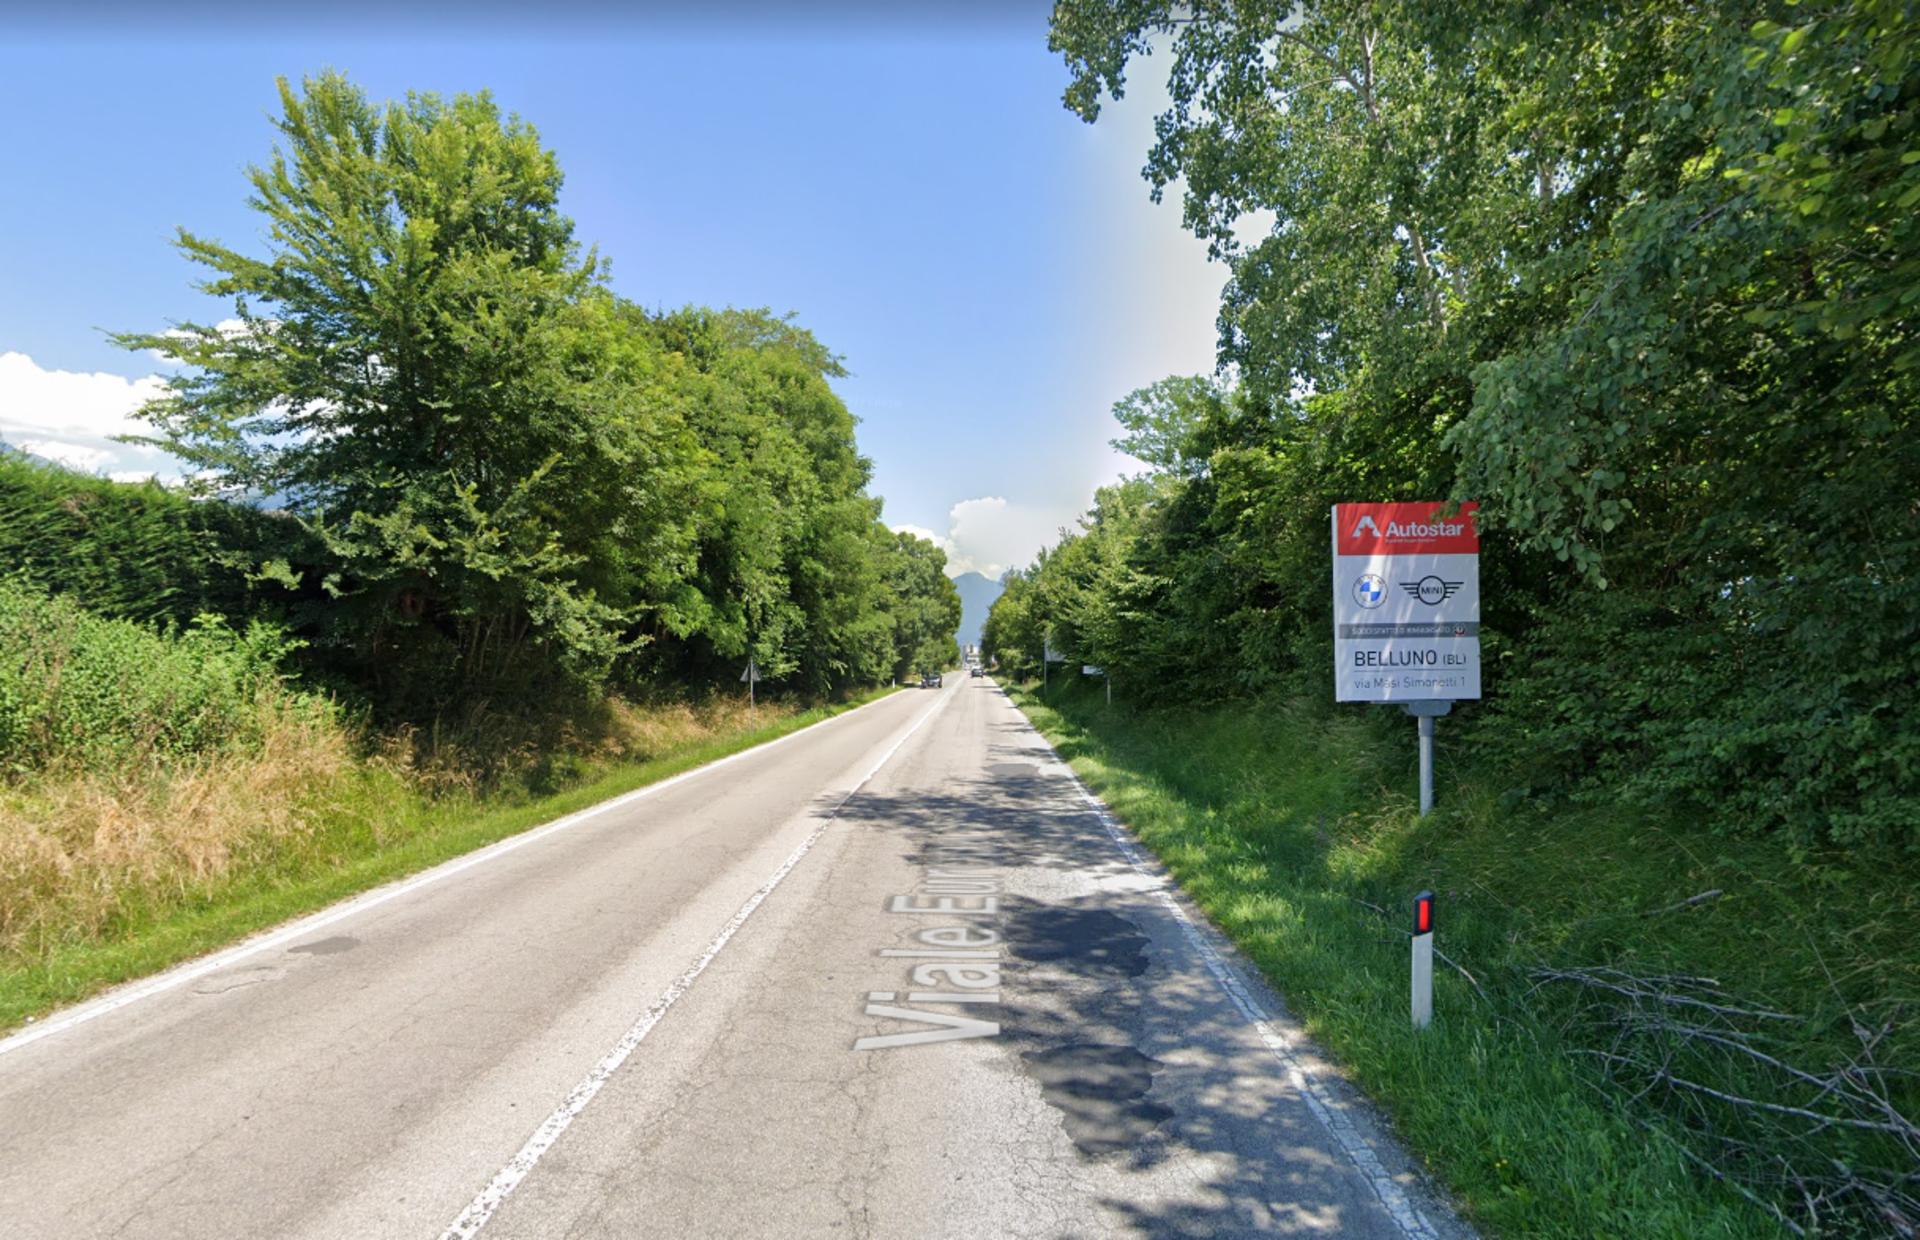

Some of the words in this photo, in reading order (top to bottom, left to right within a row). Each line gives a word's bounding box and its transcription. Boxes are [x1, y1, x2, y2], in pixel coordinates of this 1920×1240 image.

[1385, 521, 1465, 537] Autostar
[1421, 586, 1443, 595] MINI
[1354, 650, 1437, 667] BELLUNO
[1442, 653, 1467, 666] (BL)
[1354, 679, 1371, 689] via
